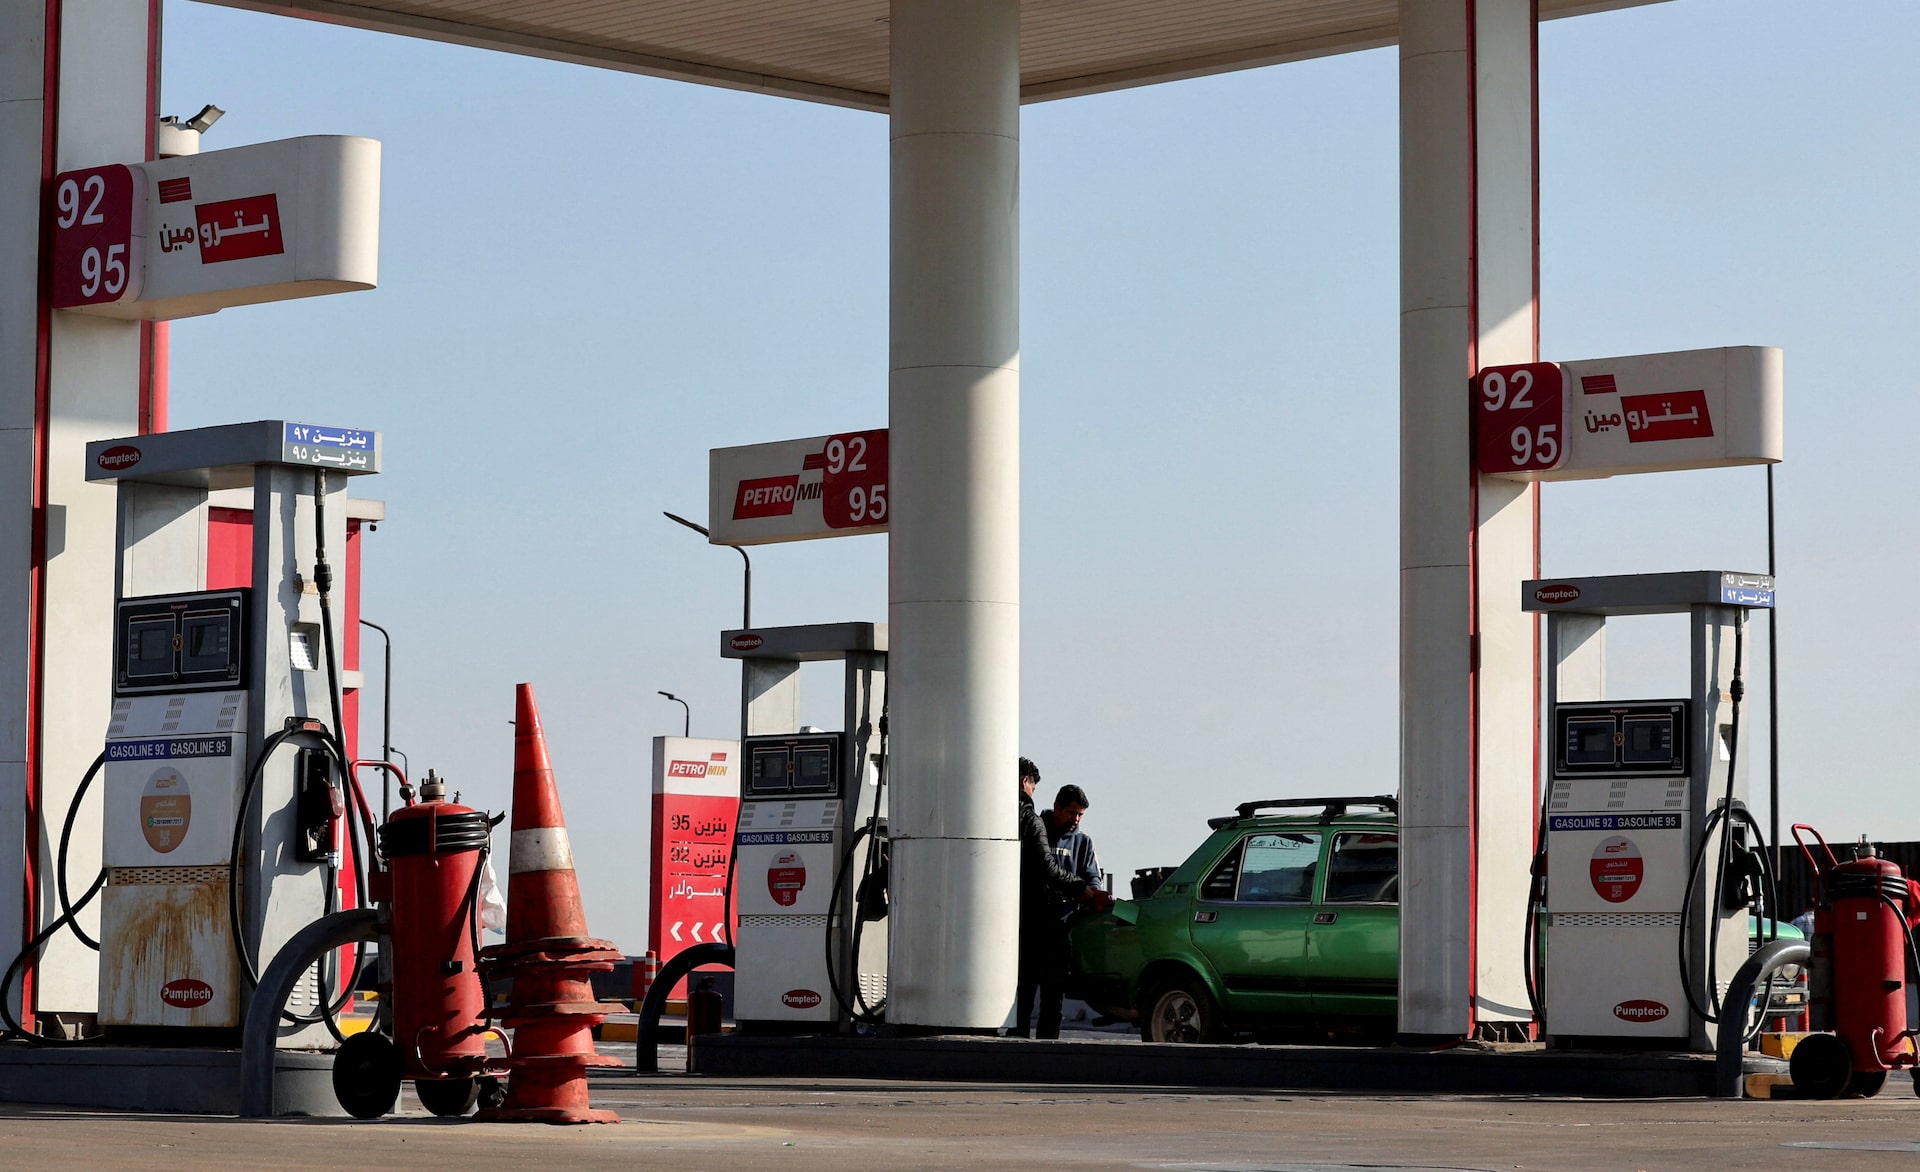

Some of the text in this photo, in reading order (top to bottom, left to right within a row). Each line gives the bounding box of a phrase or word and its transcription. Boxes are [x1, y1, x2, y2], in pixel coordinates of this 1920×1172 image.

[57, 175, 106, 230] 92
[159, 209, 270, 254] بترومين
[81, 243, 126, 298] 95
[1482, 369, 1534, 412] 92
[1584, 401, 1700, 434] بترومين
[294, 426, 367, 449] بنزين ٩٢
[1510, 423, 1558, 466] 95
[100, 450, 140, 465] Pumptech
[292, 445, 367, 469] بنزين ٩٥
[826, 436, 867, 475] 92
[848, 484, 887, 522] 95
[1726, 574, 1735, 584] ٩٥
[1536, 589, 1579, 600] Pumptech
[1727, 589, 1737, 601] ٩٢
[731, 638, 763, 648] Pumptech
[110, 740, 226, 758] GASOLINE 92 GASOLINE 95
[671, 763, 728, 776] PETROMIN
[671, 814, 727, 837] بنزين 95
[1555, 816, 1676, 829] GASOLINE 92 GASOLINE 95
[741, 832, 829, 843] GASOLINE 92 GASOLINE 95
[670, 846, 726, 869] بنزين 92
[162, 987, 211, 1001] Pumptech
[783, 994, 820, 1004] Pumptech
[1616, 1006, 1666, 1018] Pumptech
